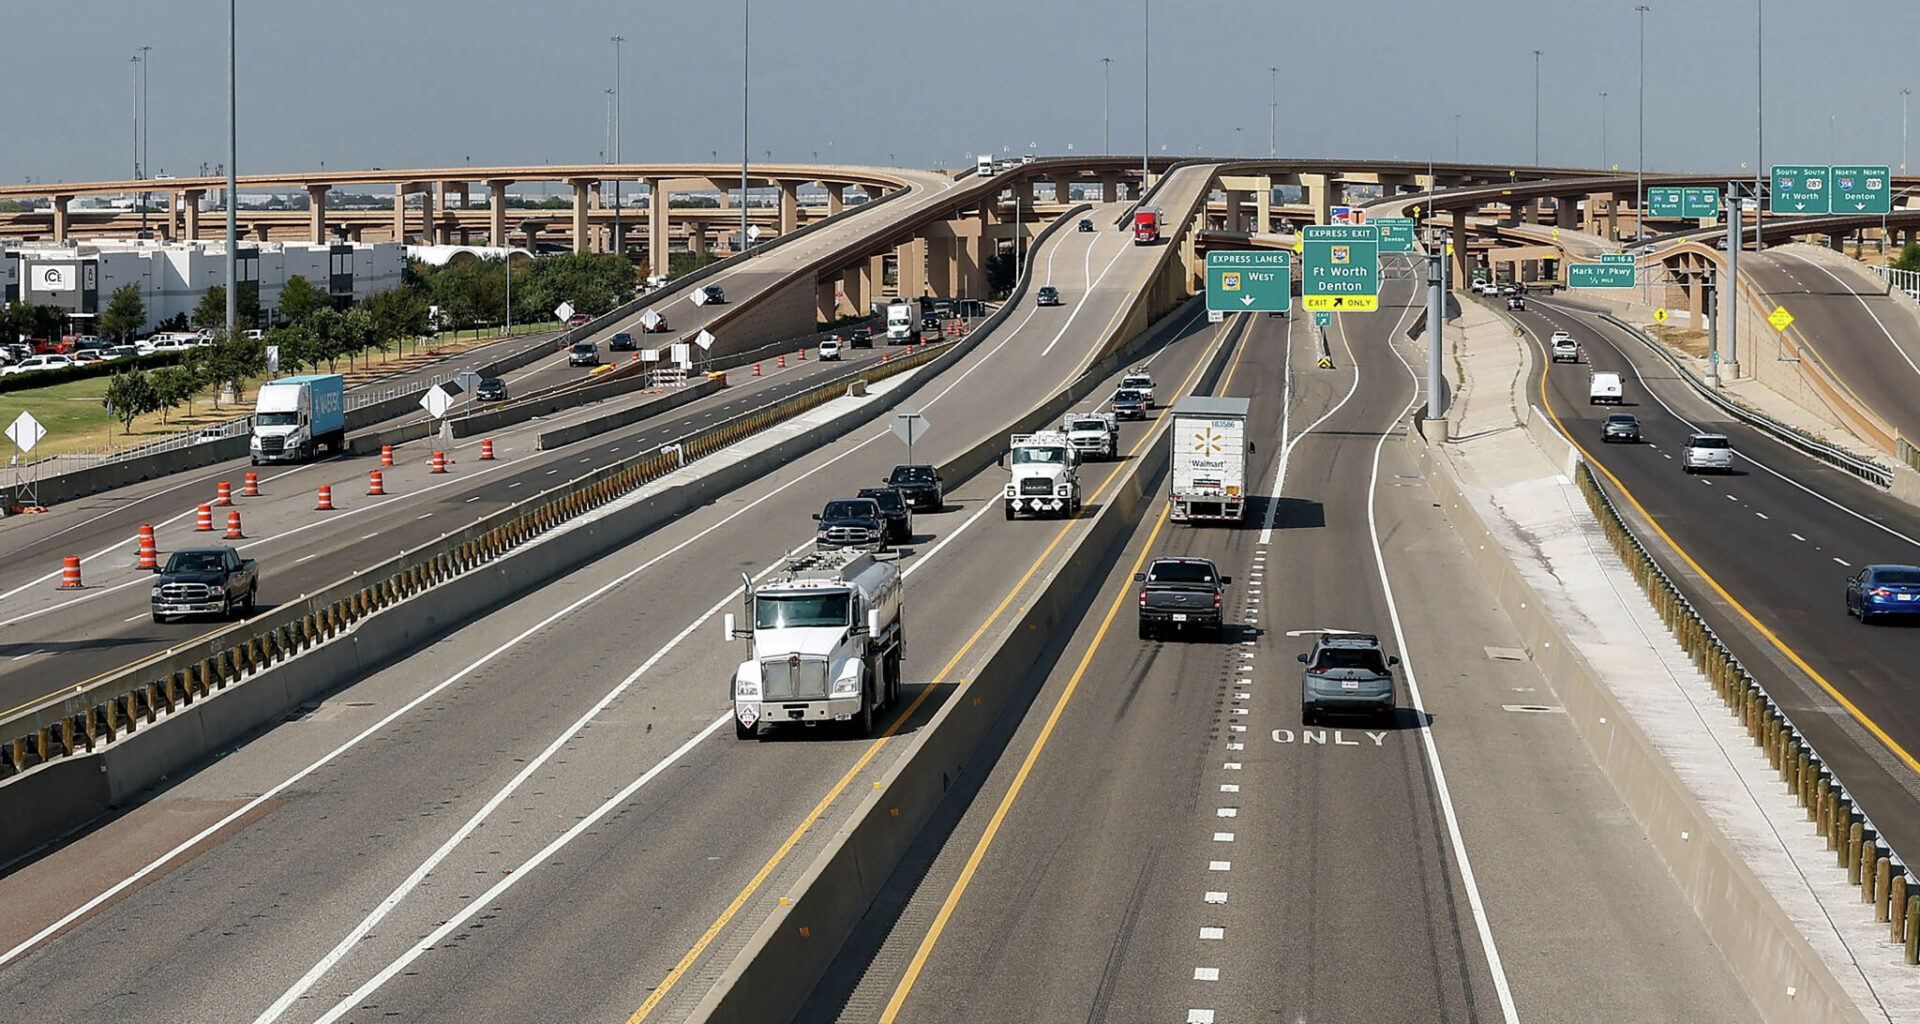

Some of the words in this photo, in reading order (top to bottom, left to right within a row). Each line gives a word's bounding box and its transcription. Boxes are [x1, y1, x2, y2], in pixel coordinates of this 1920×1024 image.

[1807, 180, 1821, 188] 287
[1867, 180, 1881, 188] 287
[1213, 255, 1251, 263] EXPRESS
[1255, 255, 1284, 263] LANES
[1249, 271, 1275, 280] WEST
[1313, 267, 1325, 276] Ft
[1331, 267, 1367, 276] Worth
[1609, 268, 1631, 276] Pkwy
[1318, 281, 1362, 291] Denton
[1308, 299, 1328, 307] EXIT
[1347, 299, 1371, 307] ONLY
[1192, 460, 1224, 468] Walmart
[1271, 729, 1388, 747] ONLY
